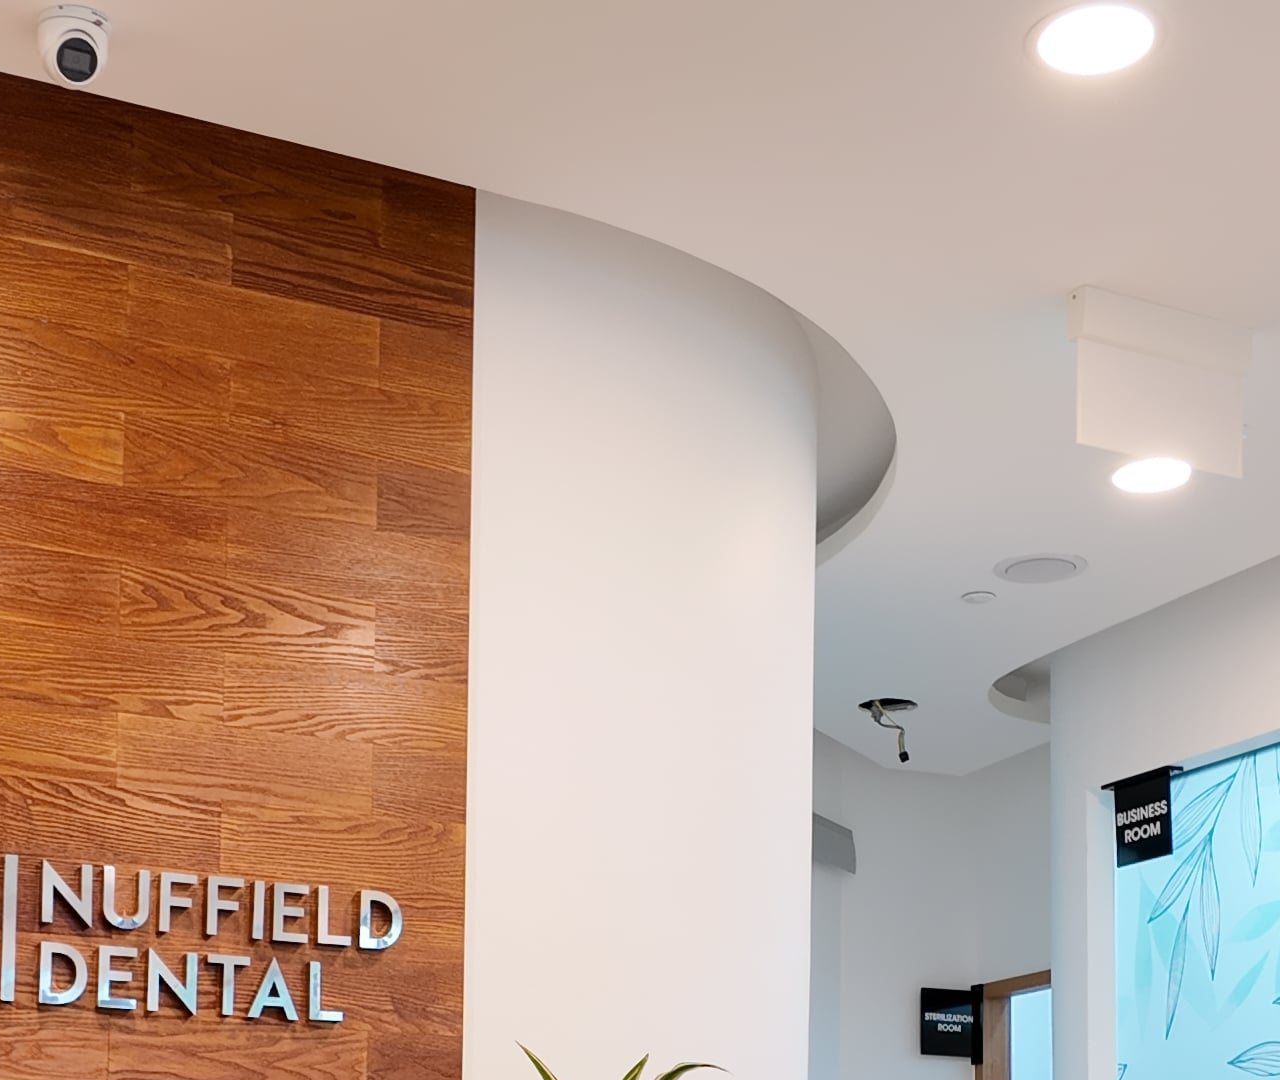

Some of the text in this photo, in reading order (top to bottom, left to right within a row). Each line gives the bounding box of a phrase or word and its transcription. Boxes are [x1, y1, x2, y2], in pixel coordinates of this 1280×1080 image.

[1117, 800, 1168, 826] BUSINESS
[1124, 821, 1161, 844] ROOM
[41, 858, 404, 952] NUFFIELD
[37, 940, 345, 1024] DENTAL
[924, 1012, 974, 1024] STERILIZATION
[937, 1023, 962, 1033] ROOM
